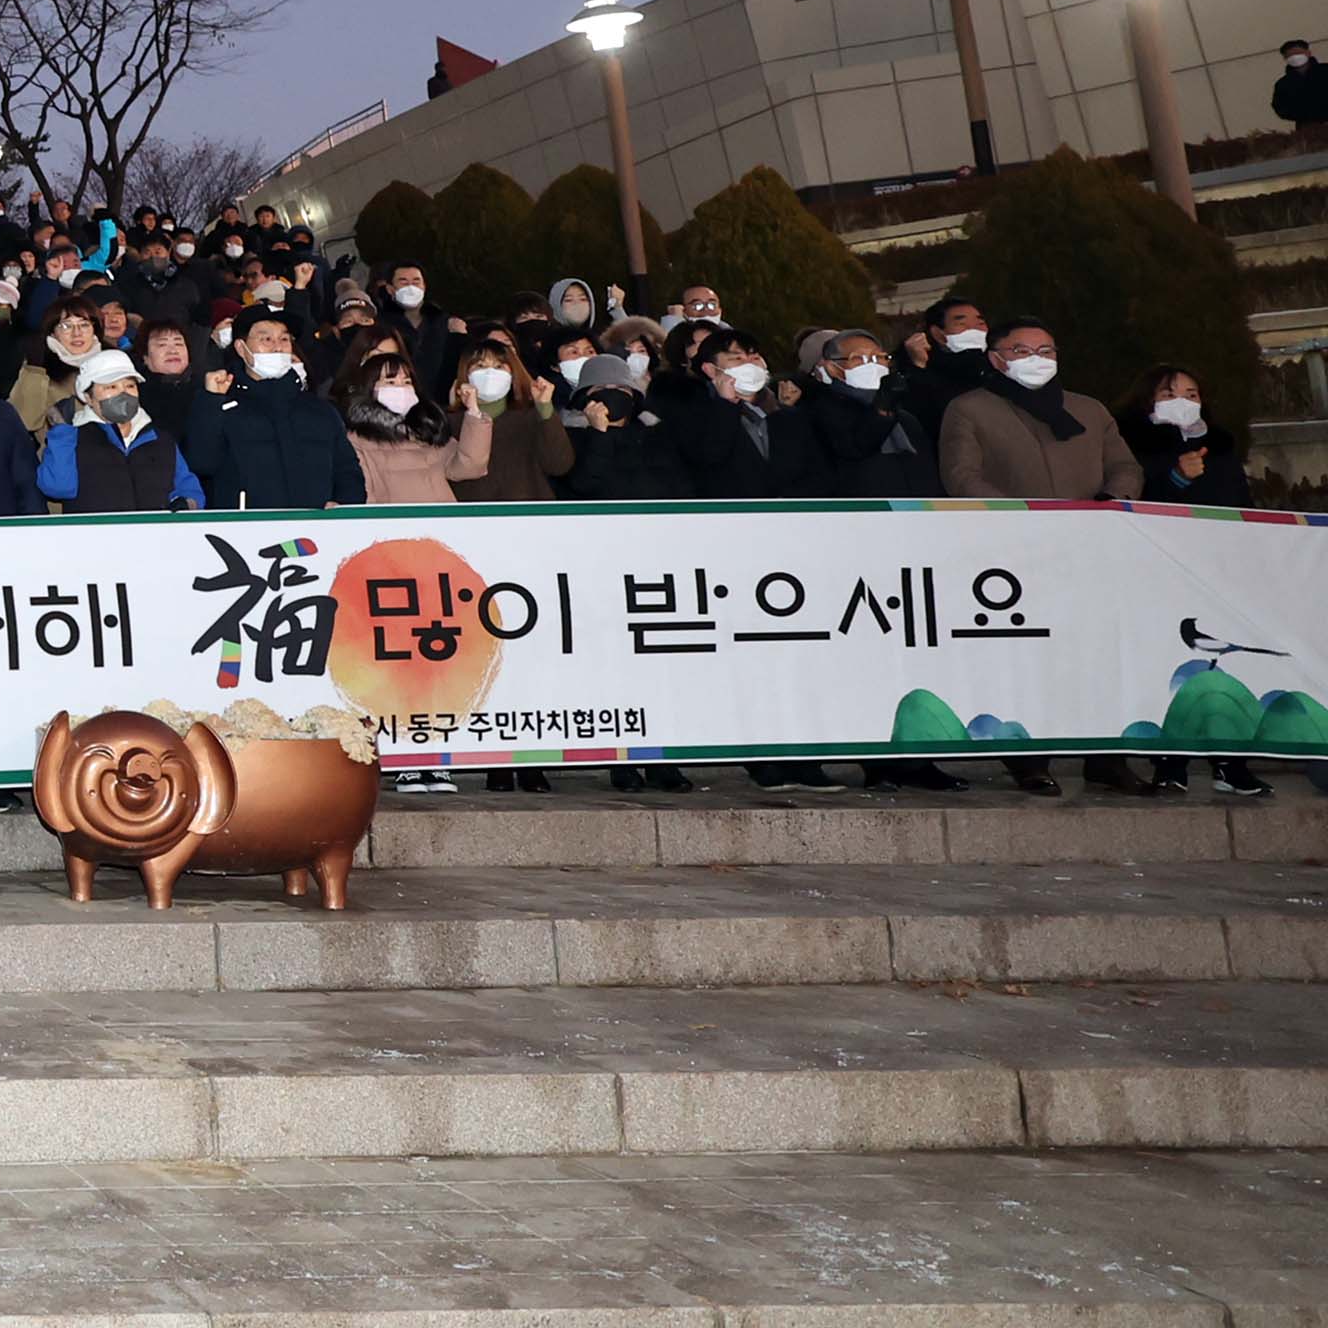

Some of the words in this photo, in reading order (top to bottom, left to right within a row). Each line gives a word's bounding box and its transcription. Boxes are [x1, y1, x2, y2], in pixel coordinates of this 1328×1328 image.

[191, 534, 338, 689] 福
[366, 573, 573, 662] 많이
[624, 567, 1050, 654] 받으세요
[407, 713, 460, 744] 동구
[467, 706, 648, 742] 주민자치협의회
